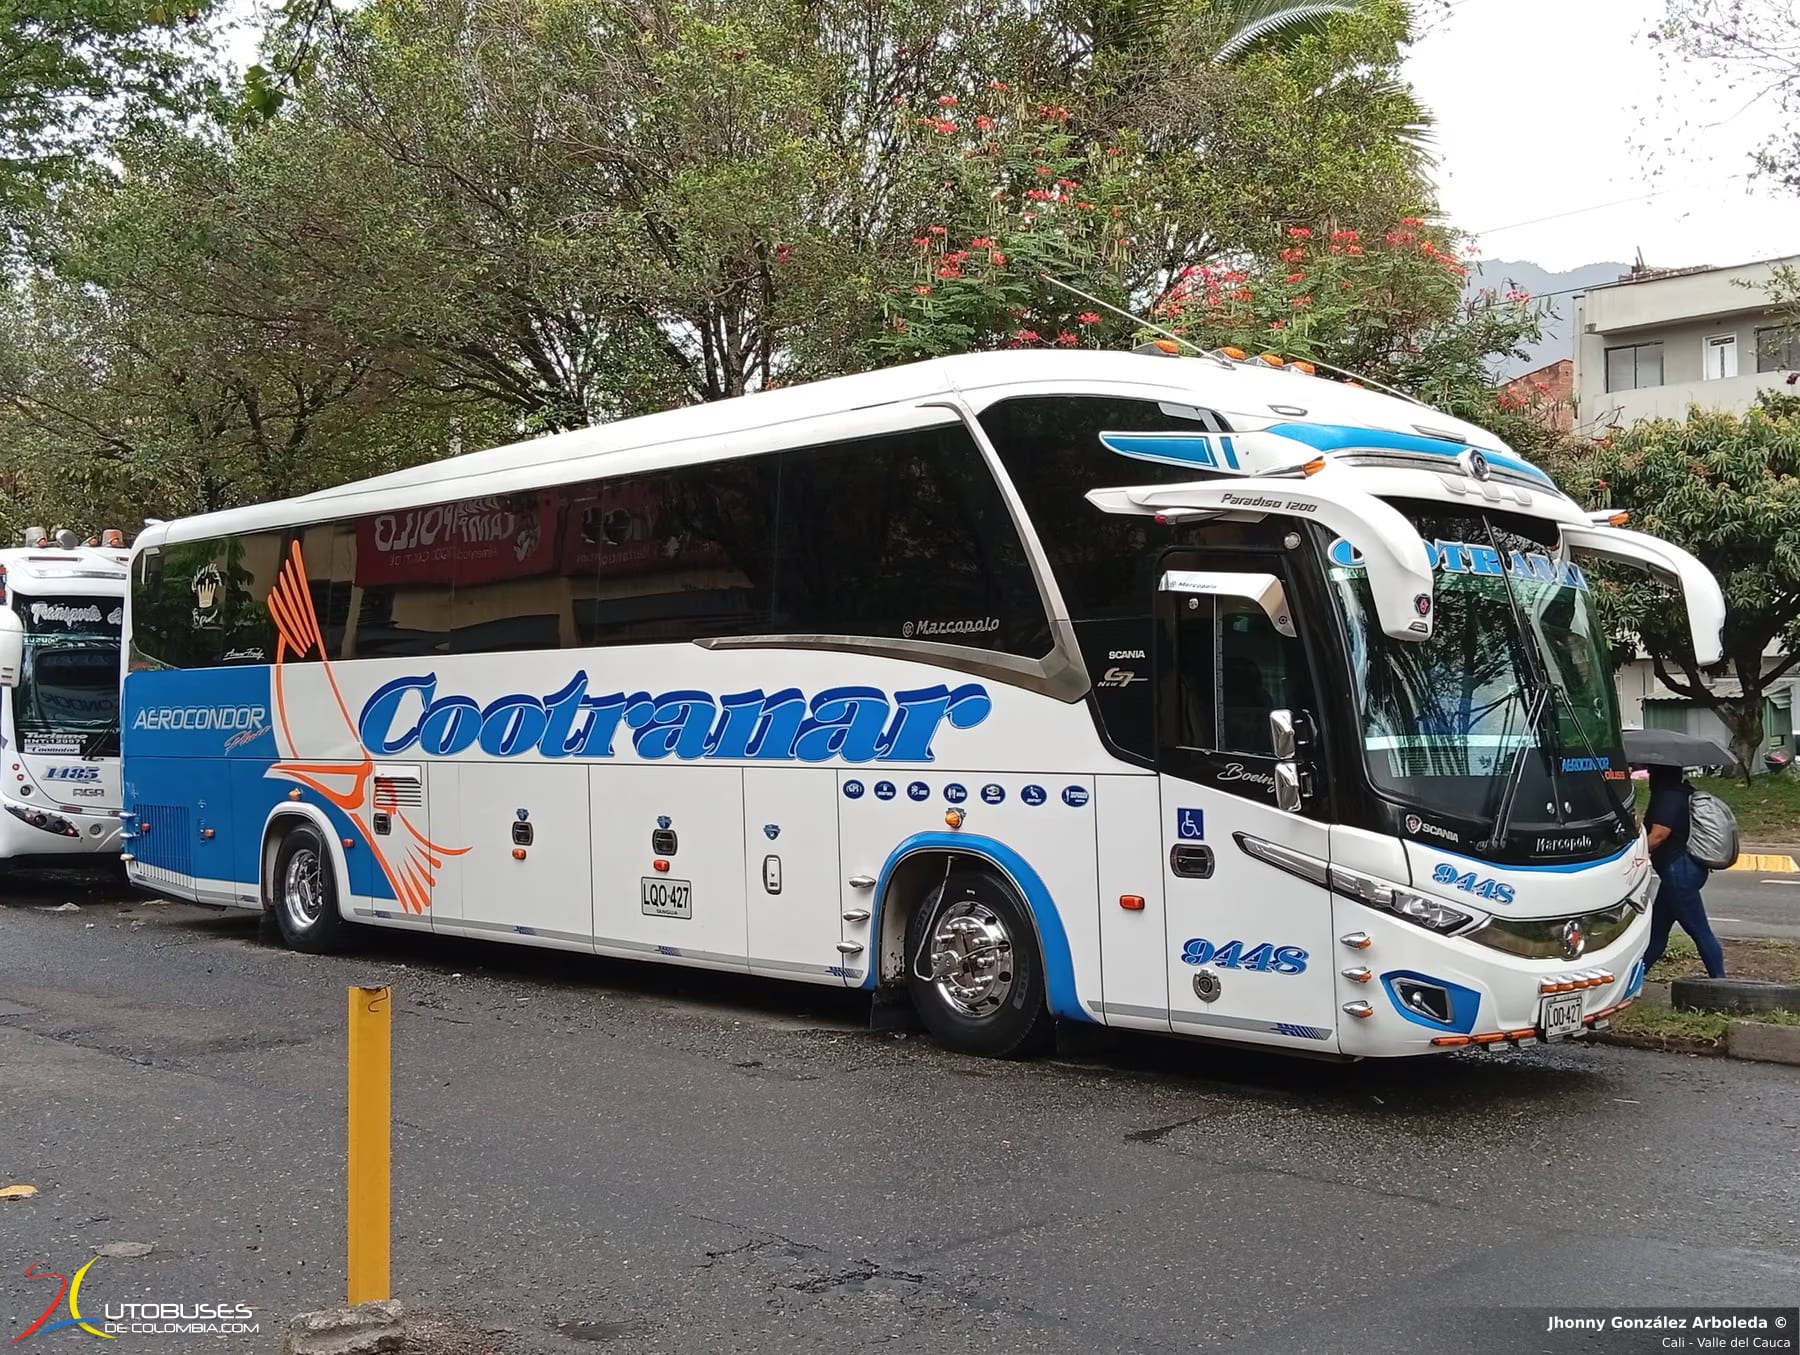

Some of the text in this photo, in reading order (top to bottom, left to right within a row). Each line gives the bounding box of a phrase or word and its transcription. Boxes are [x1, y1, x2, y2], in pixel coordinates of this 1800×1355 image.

[1221, 493, 1318, 512] Paradiso 1200
[916, 616, 1000, 635] Marcopolo
[1108, 650, 1146, 660] SCANIA
[132, 704, 266, 730] AEROCONDOR
[358, 669, 992, 763] Cootranar
[24, 731, 89, 739] Turismo
[42, 766, 102, 781] 1485
[1216, 762, 1277, 793] Boeing
[1421, 822, 1459, 843] SCANIA
[1535, 835, 1592, 852] Marcopolo
[1431, 863, 1516, 905] 9448
[1180, 937, 1310, 976] 9448
